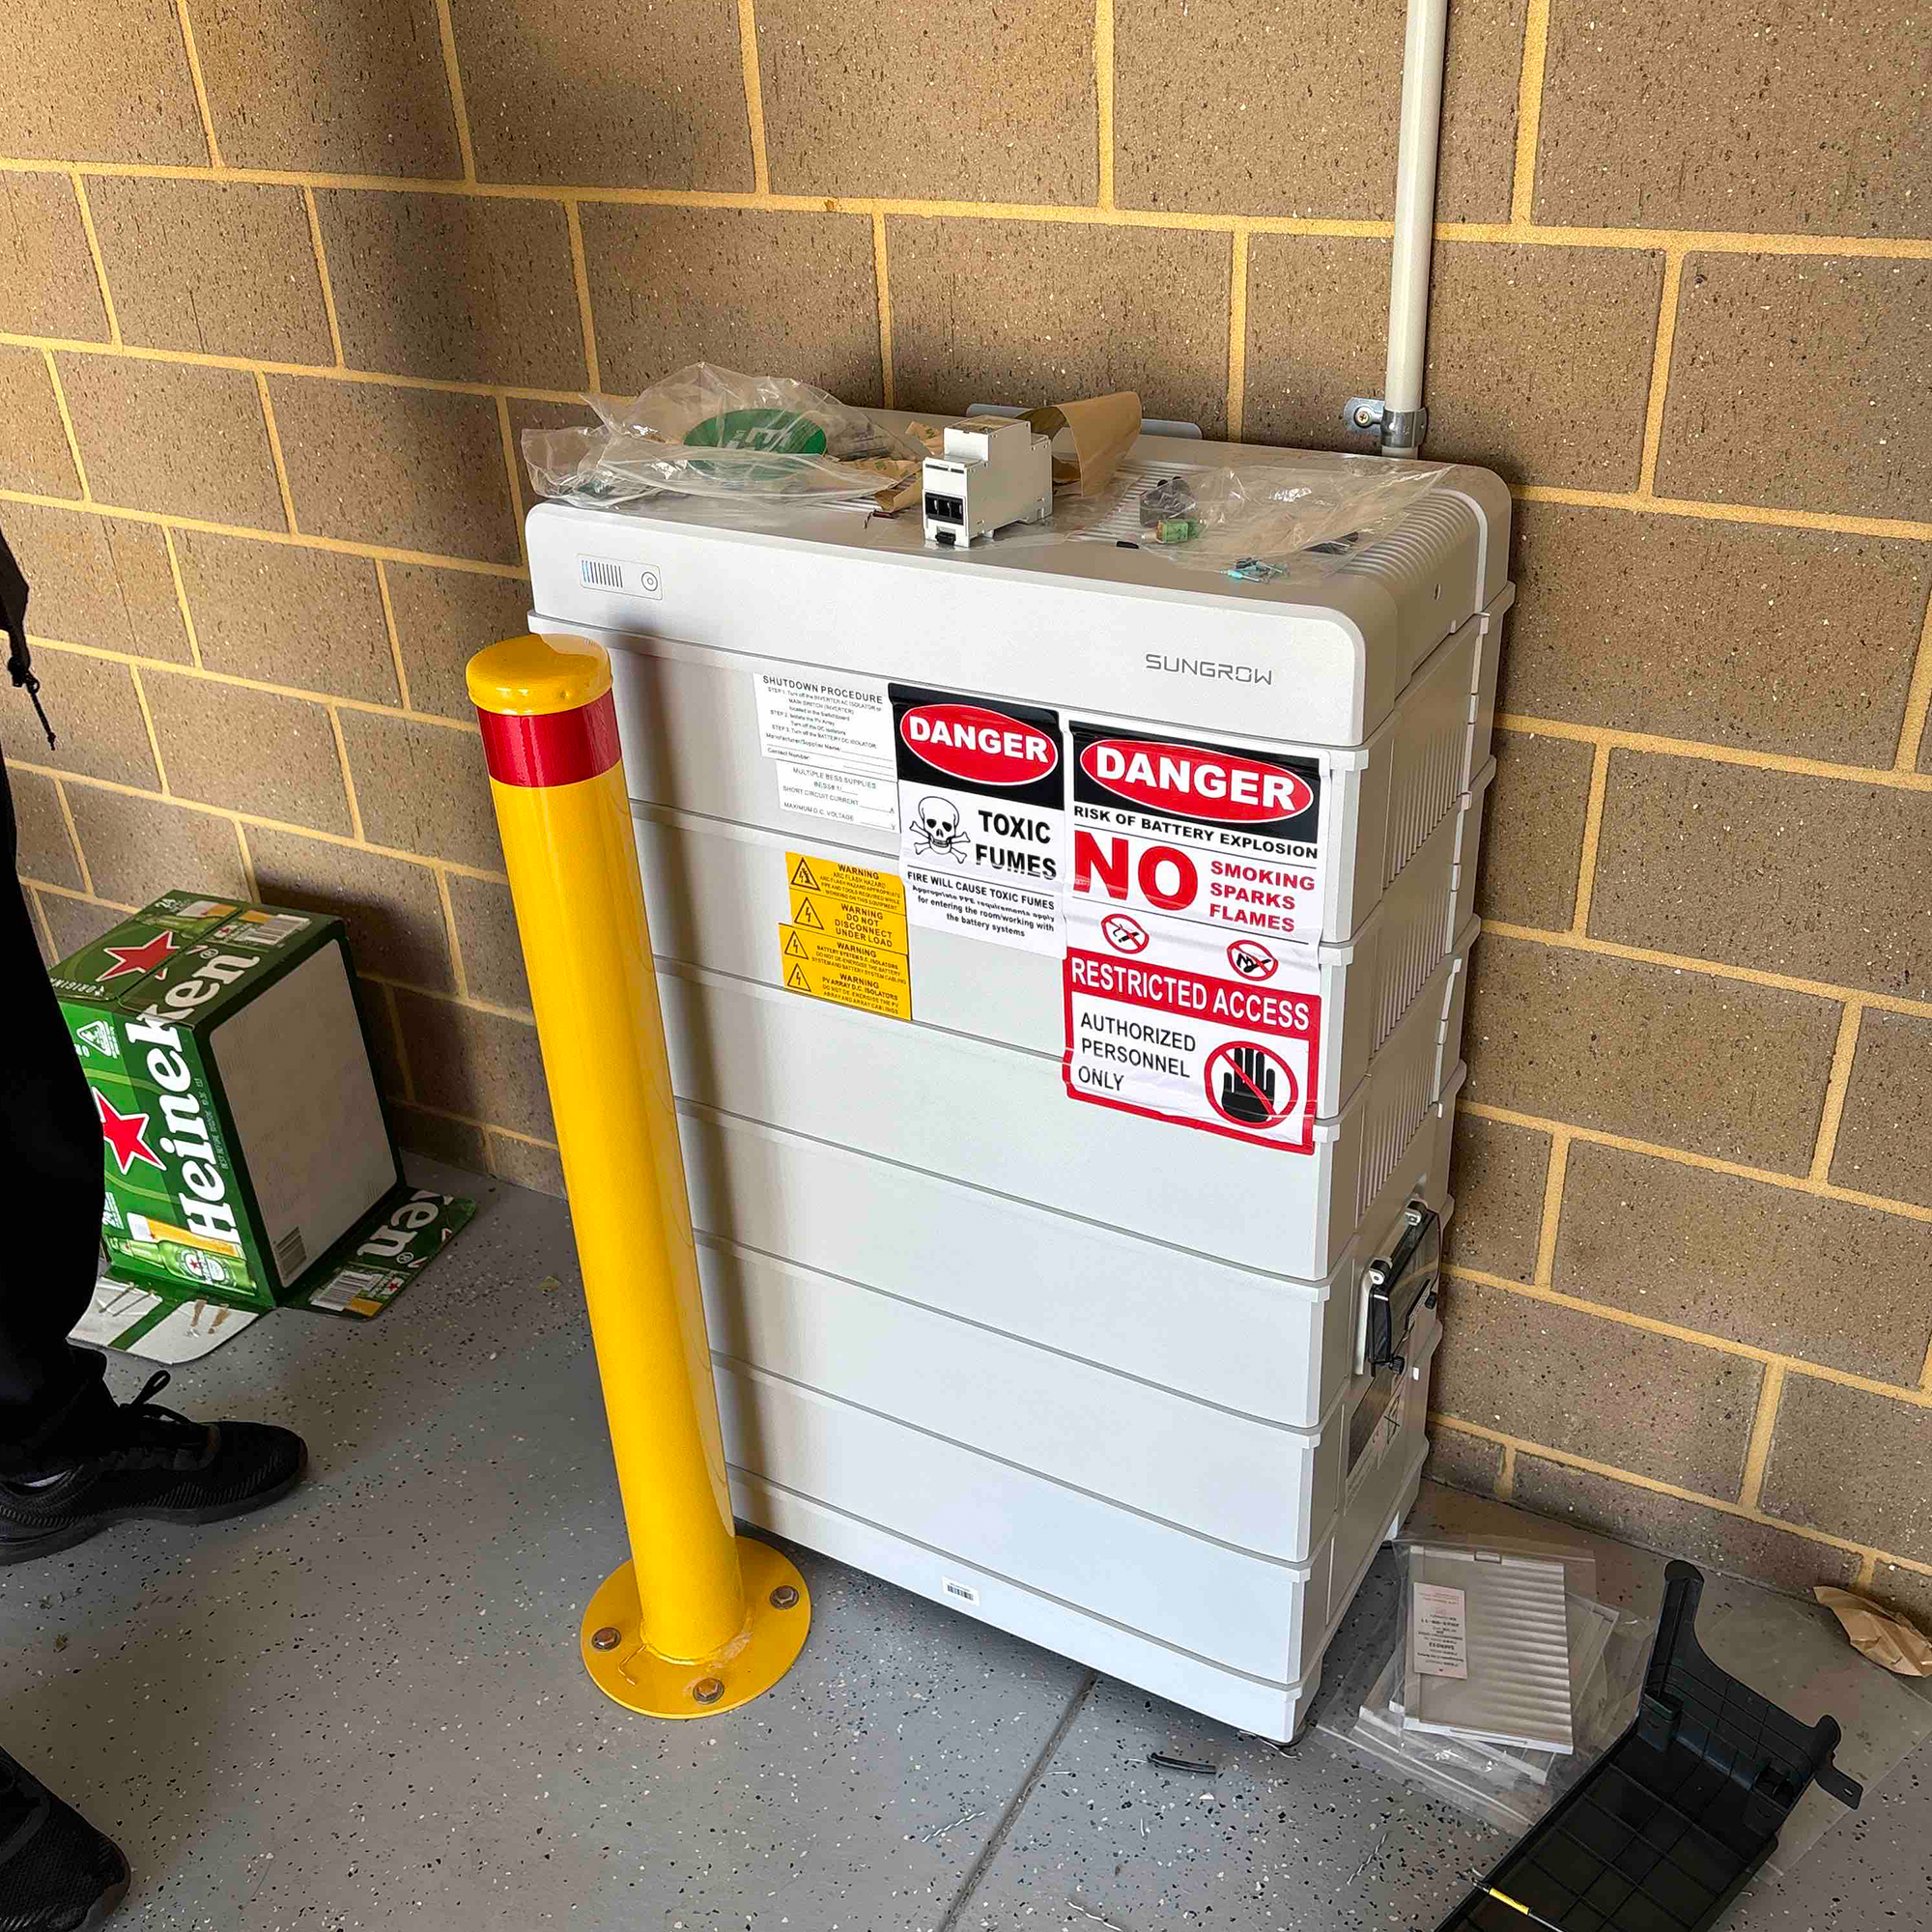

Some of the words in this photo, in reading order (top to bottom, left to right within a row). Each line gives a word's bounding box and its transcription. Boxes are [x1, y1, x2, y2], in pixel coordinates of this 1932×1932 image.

[1146, 653, 1272, 686] SUNGROW
[763, 675, 818, 693] SHUTDOWN
[821, 686, 883, 704] PROCEDURE
[908, 715, 1049, 764] DANGER
[793, 767, 824, 780] MULTIPLE
[843, 777, 877, 789] SUPPLIES
[1095, 744, 1296, 812] DANGER
[782, 785, 804, 795] SHORT
[805, 789, 828, 800] CIRCUIT
[829, 794, 859, 806] CURRENT
[783, 802, 812, 812] MAXIMUM
[827, 810, 854, 821] VOLTAGE
[977, 809, 1051, 844] TOXIC
[1073, 805, 1111, 825] RISK
[1115, 811, 1137, 828] OF
[1141, 813, 1214, 842] BATTERY
[1219, 831, 1319, 860] EXPLOSION
[838, 863, 879, 880] WARNING
[975, 842, 1057, 881] FUMES
[1073, 830, 1199, 912] NO
[1210, 860, 1315, 892] SMOKING
[907, 871, 928, 883] FIRE
[930, 876, 953, 889] WILL
[955, 881, 987, 895] CAUSE
[989, 889, 1018, 903] TOXIC
[1021, 895, 1054, 910] FUMES
[1209, 881, 1296, 911] SPARKS
[841, 903, 883, 920] WARNING
[846, 913, 859, 923] DO
[861, 917, 879, 927] NOT
[918, 895, 928, 904] for
[930, 899, 963, 914] entering
[965, 905, 978, 915] the
[1037, 922, 1054, 932] with
[947, 913, 959, 922] the
[961, 917, 990, 930] battery
[992, 923, 1025, 937] systems
[1209, 903, 1295, 933] FLAMES
[835, 919, 893, 939] DISCONNECT
[836, 928, 867, 941] UNDER
[869, 936, 893, 948] LOAD
[837, 941, 876, 957] WARNING
[49, 977, 97, 993] ORIGINA
[839, 973, 879, 989] WARNING
[1071, 957, 1208, 1012] RESTRICTED
[1212, 990, 1310, 1032] ACCESS
[1080, 1011, 1197, 1054] AUTHORIZED
[1081, 1037, 1191, 1079] PERSONNEL
[1078, 1065, 1125, 1093] ONLY
